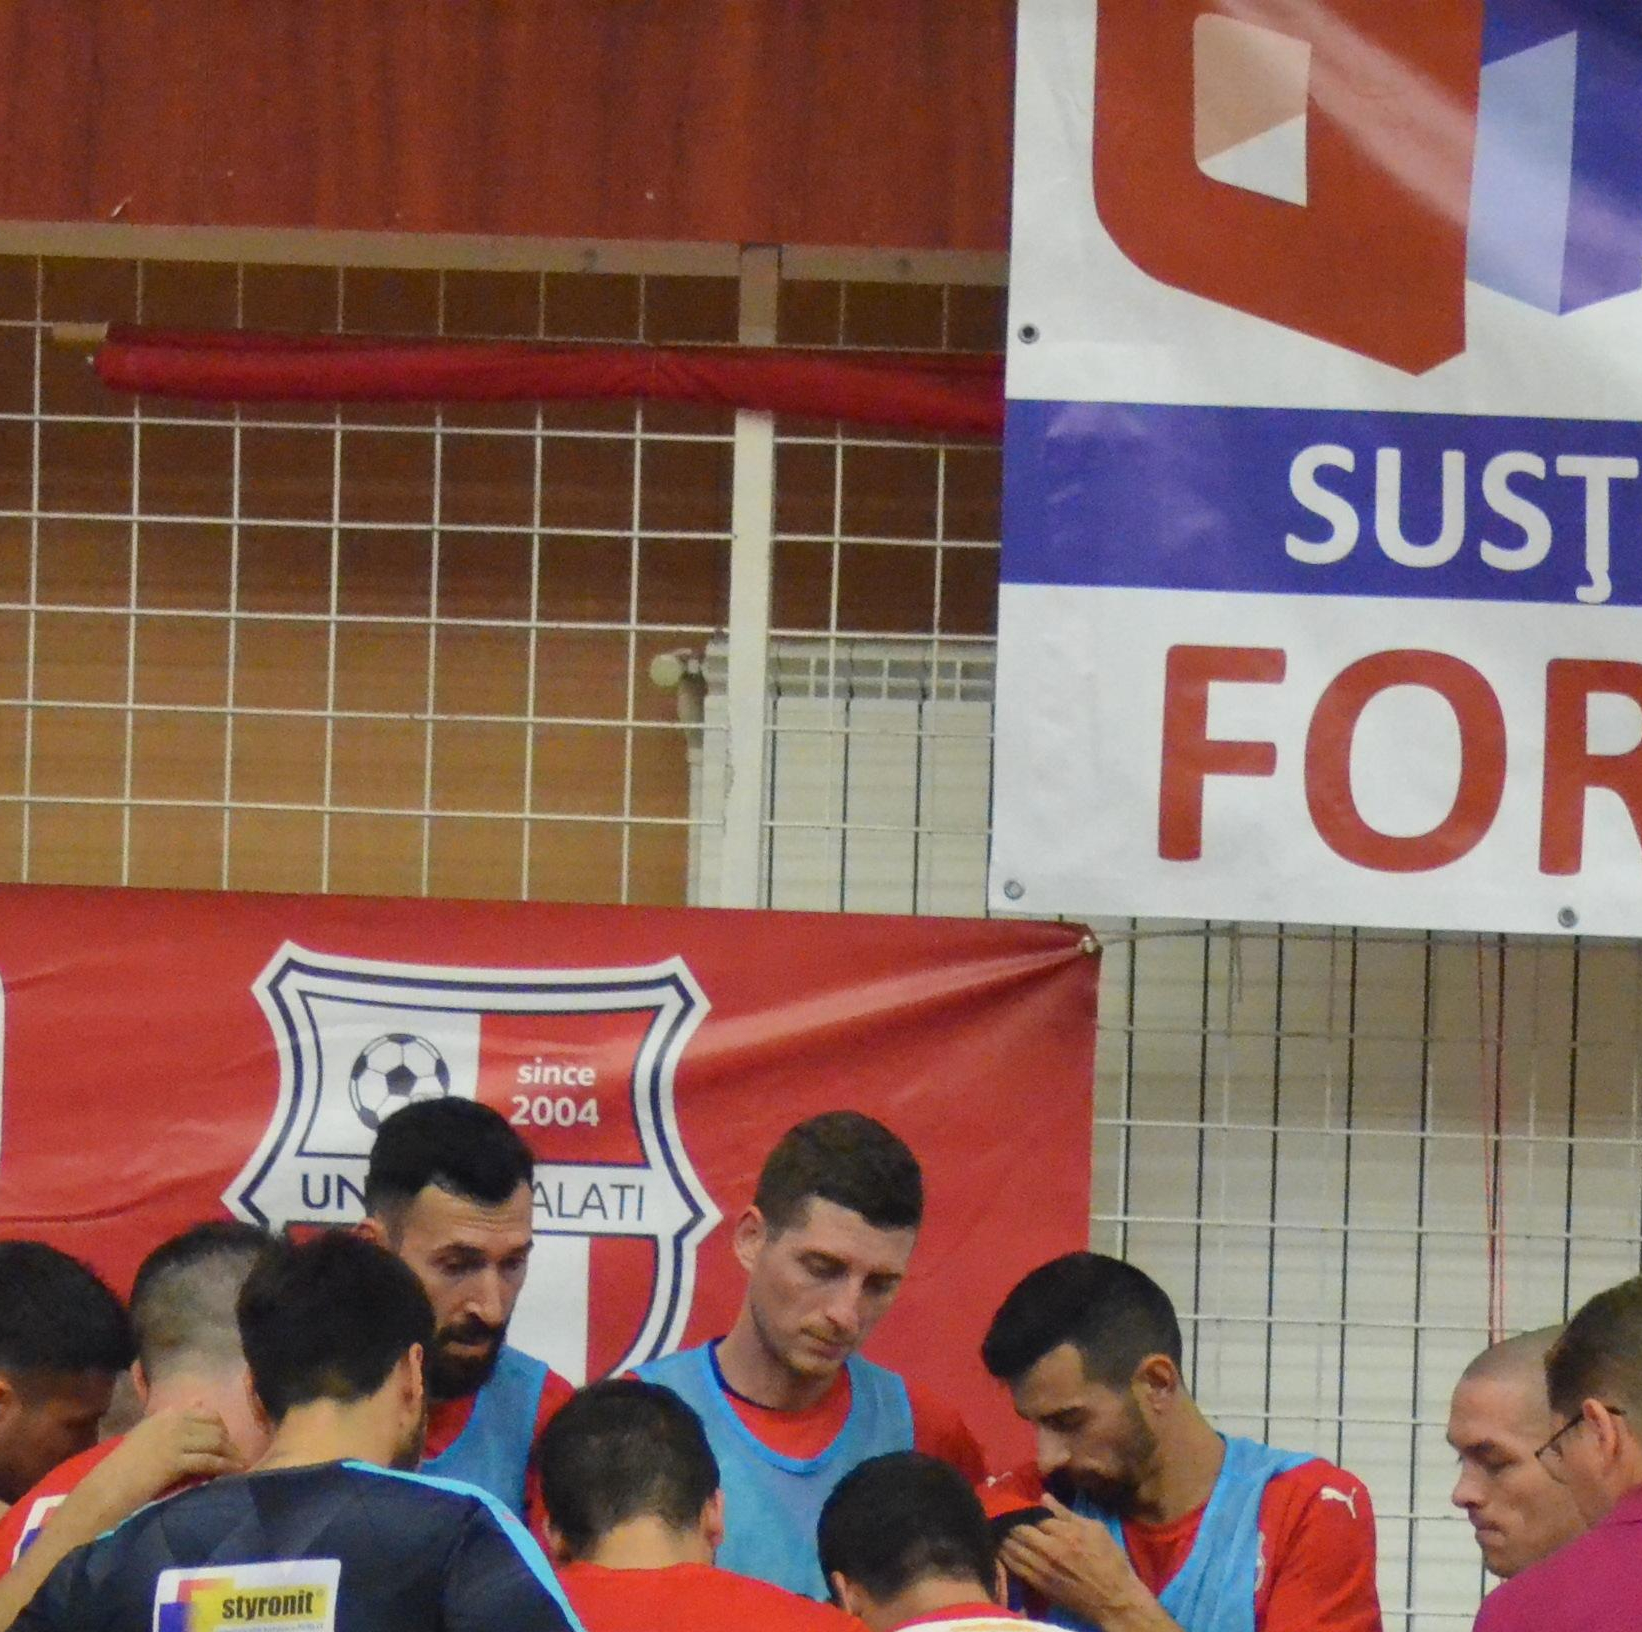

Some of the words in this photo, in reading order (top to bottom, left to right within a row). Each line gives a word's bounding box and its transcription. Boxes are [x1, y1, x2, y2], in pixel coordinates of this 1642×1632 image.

[516, 1057, 597, 1087] since
[510, 1095, 600, 1128] 2004
[532, 1180, 644, 1221] ALATI
[222, 1589, 315, 1621] styronit
